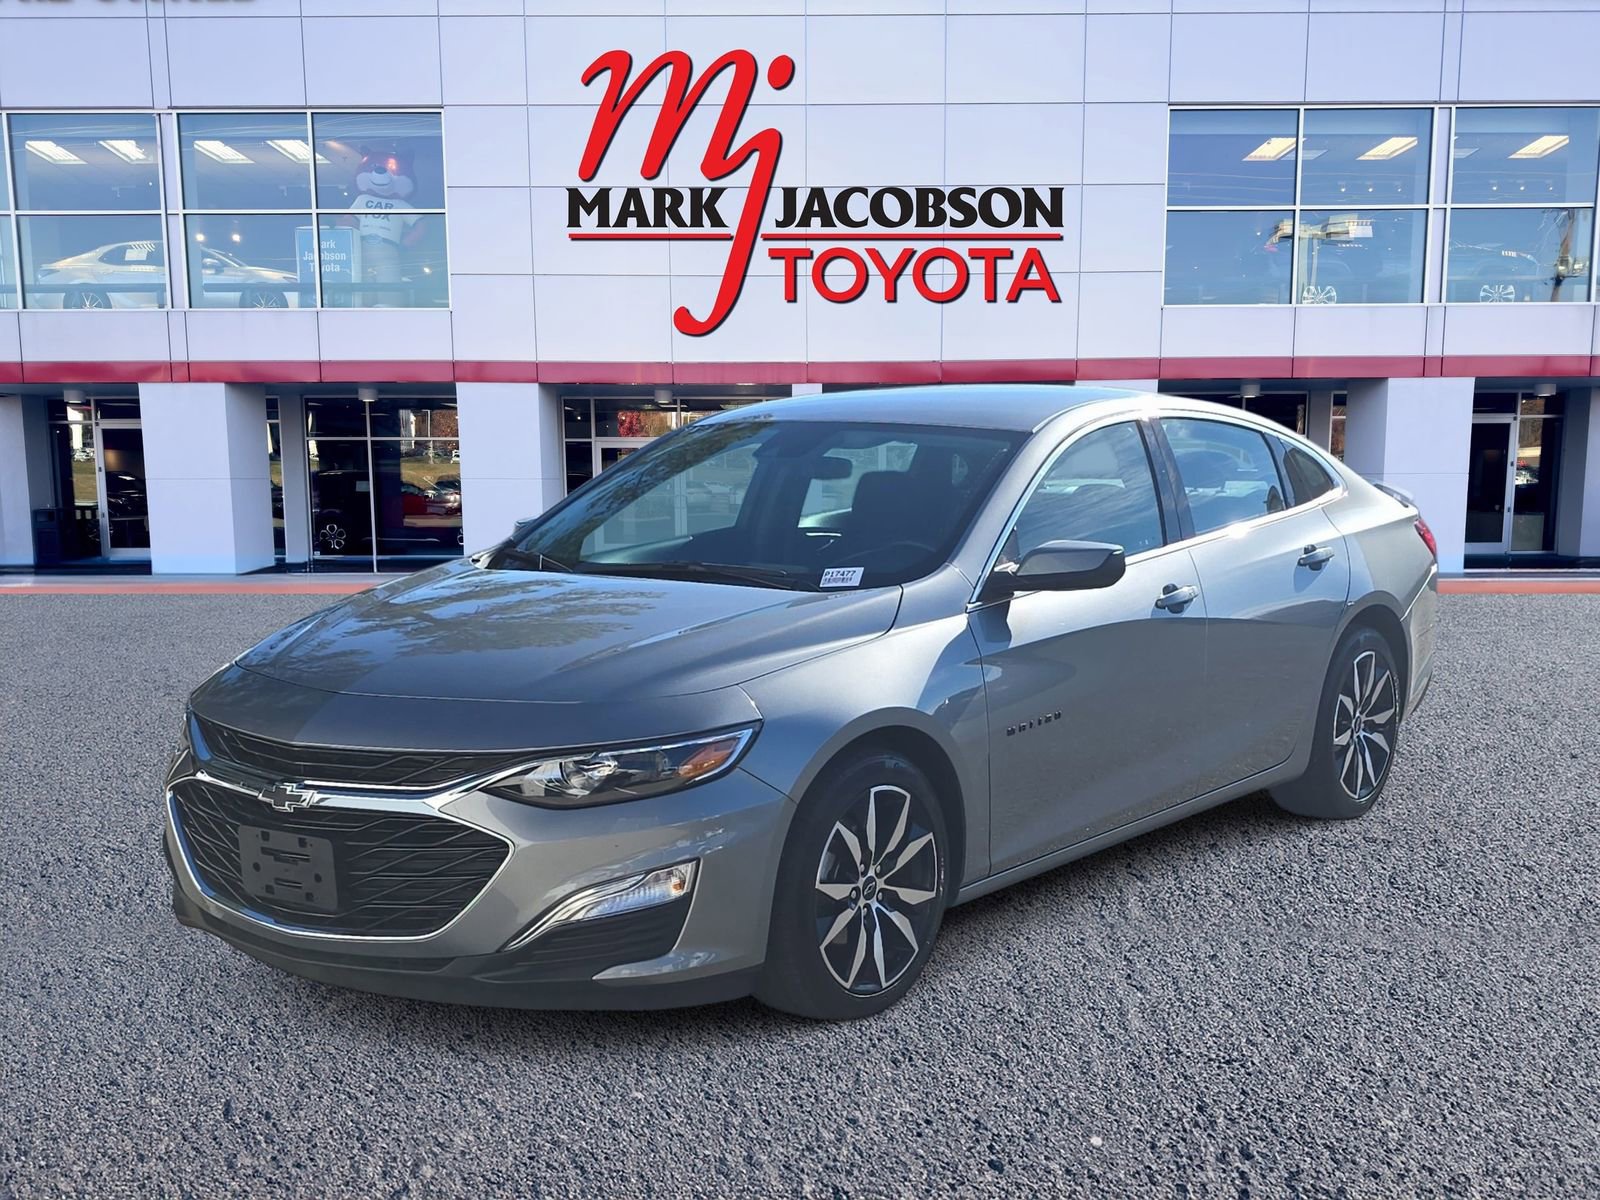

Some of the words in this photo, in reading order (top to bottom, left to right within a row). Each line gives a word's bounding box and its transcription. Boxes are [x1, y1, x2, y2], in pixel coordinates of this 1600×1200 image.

[566, 187, 729, 228] MARK
[775, 186, 1065, 228] JACOBSON
[313, 239, 336, 249] ark
[303, 251, 346, 261] Jabson
[309, 262, 340, 273] Tyota
[768, 247, 1062, 303] TOYOTA
